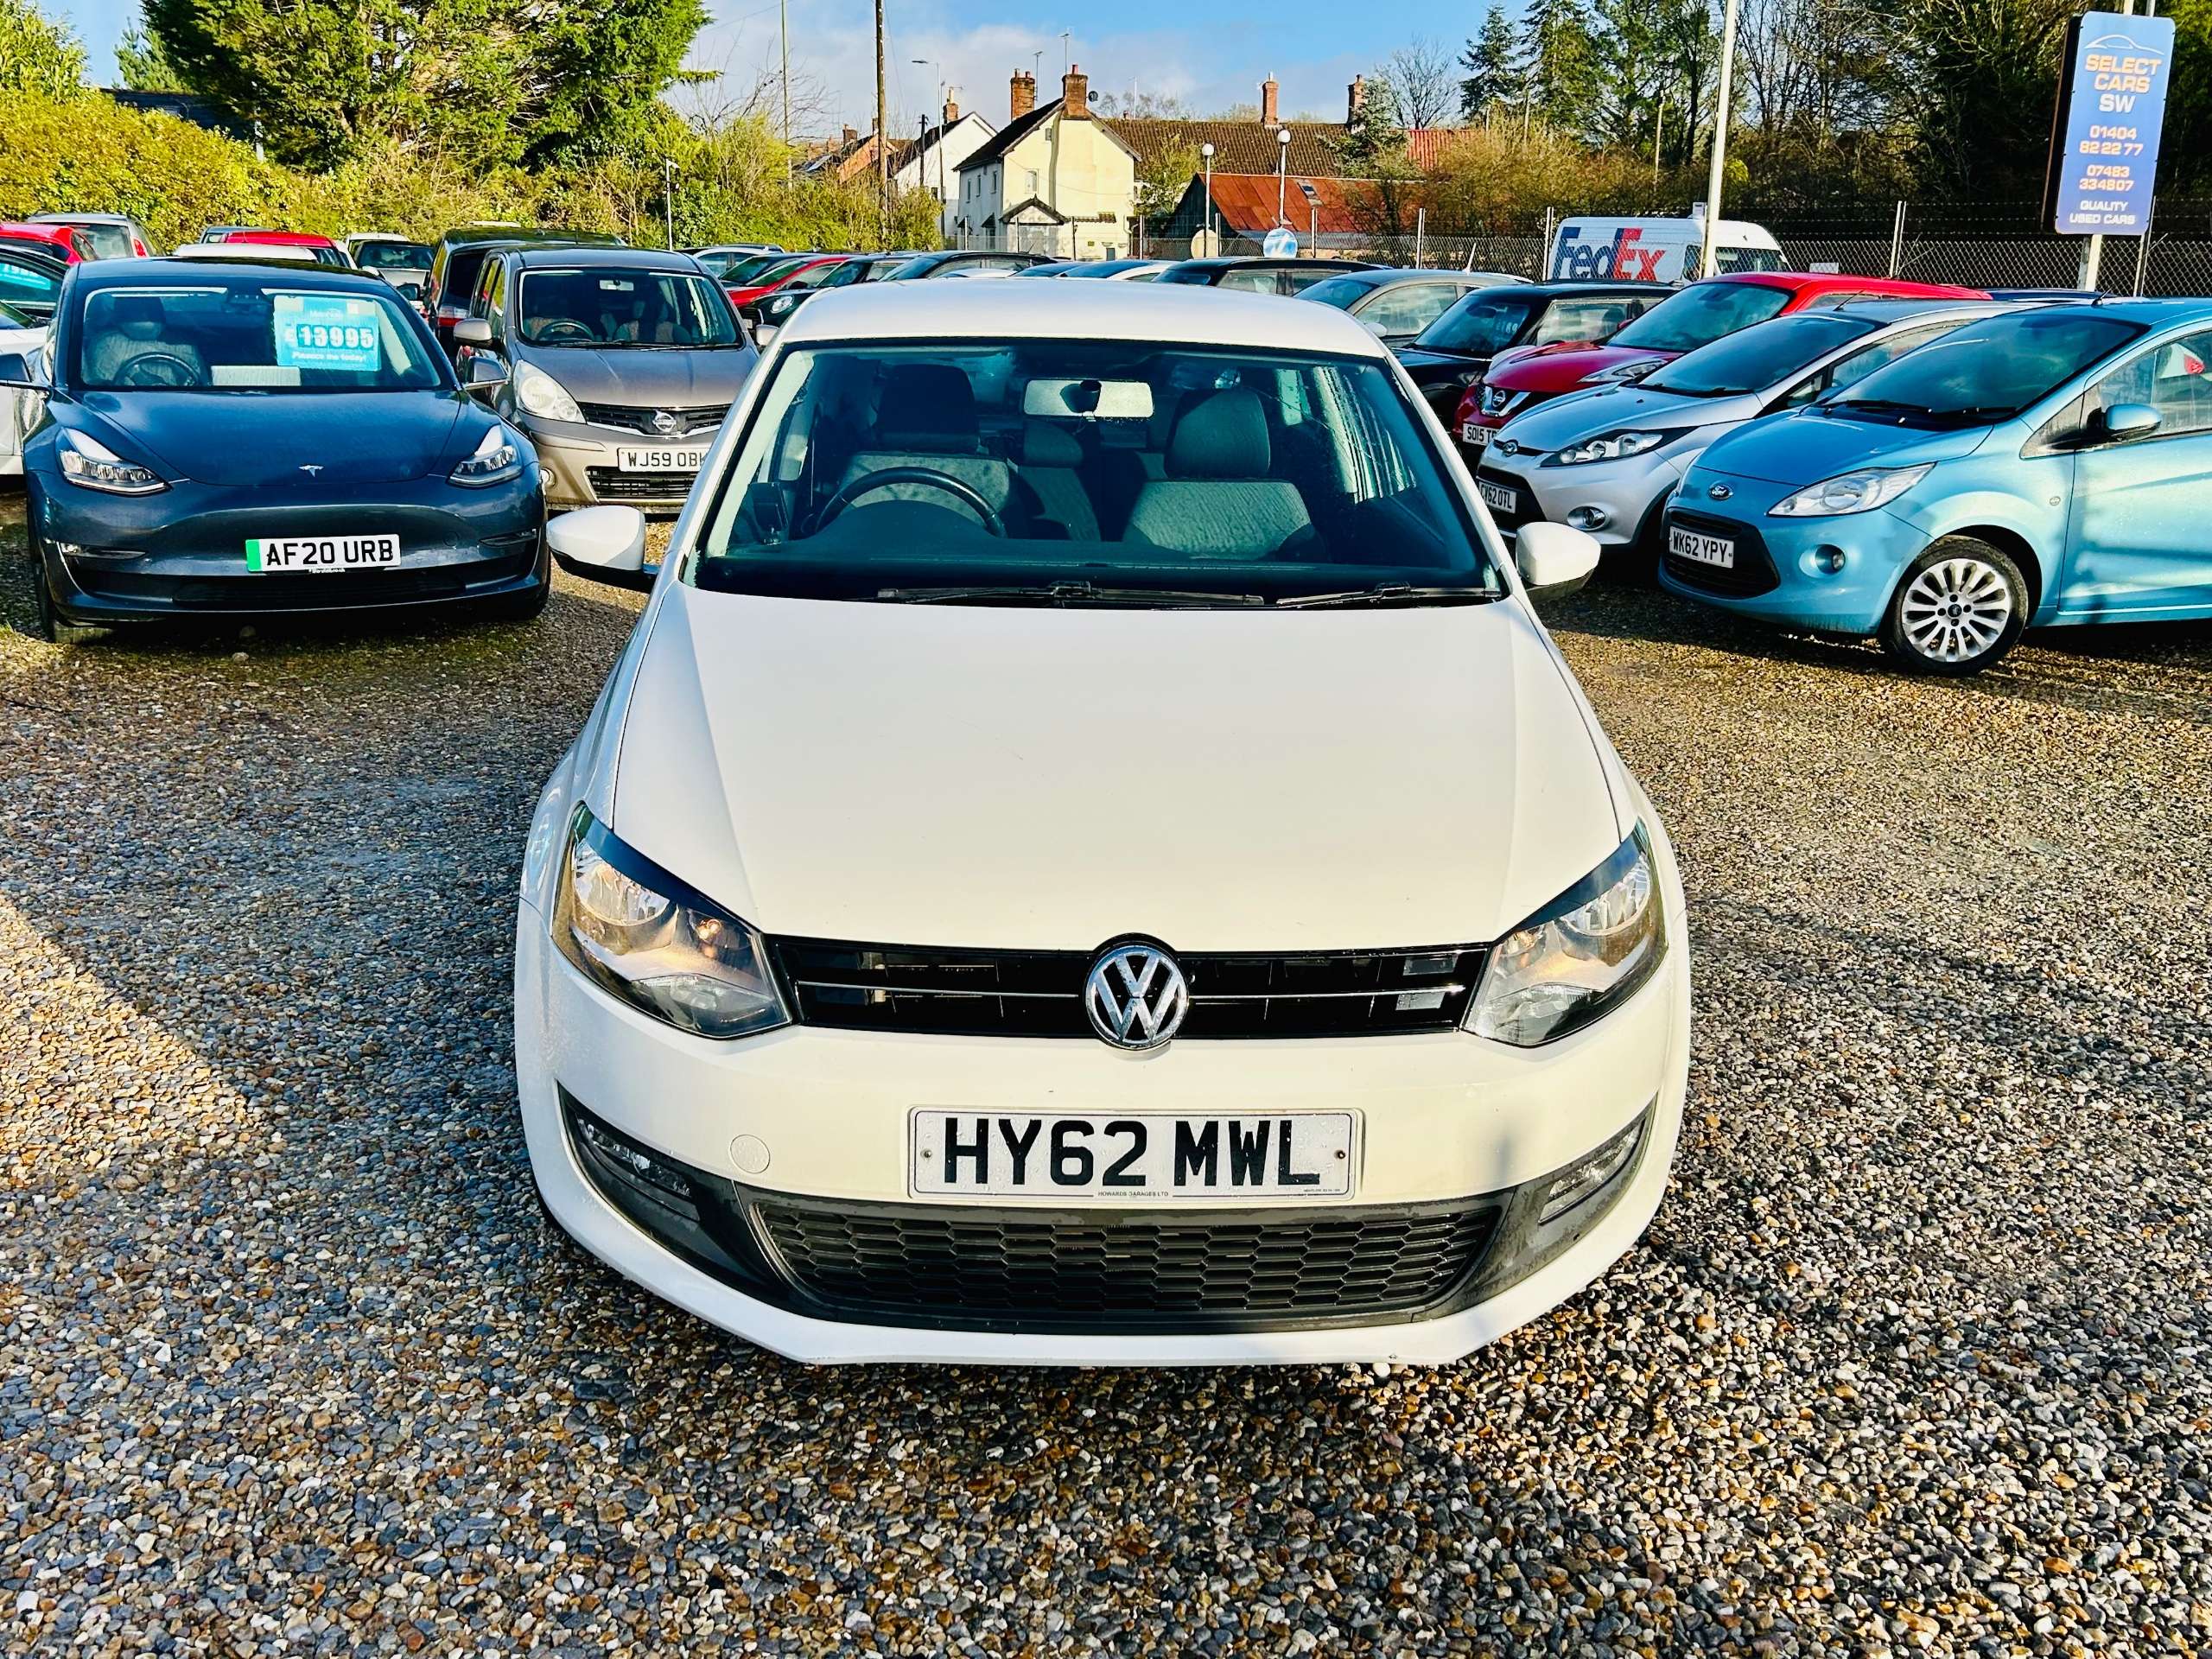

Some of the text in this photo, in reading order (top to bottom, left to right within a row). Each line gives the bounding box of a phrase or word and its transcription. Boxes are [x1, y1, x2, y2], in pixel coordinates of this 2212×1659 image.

[2085, 54, 2162, 75] SELECT
[2094, 73, 2151, 93] CARS
[2099, 93, 2136, 112] SW
[2089, 124, 2138, 140] 01404
[2080, 200, 2128, 212] QUALITY
[2069, 213, 2136, 225] USED CARS
[1552, 226, 1666, 281] FedEx
[627, 452, 671, 467] WJ59
[266, 539, 394, 565] AF20 URB
[1673, 531, 1728, 563] WK62 YPY
[944, 1116, 1320, 1186] HY62 MWL
